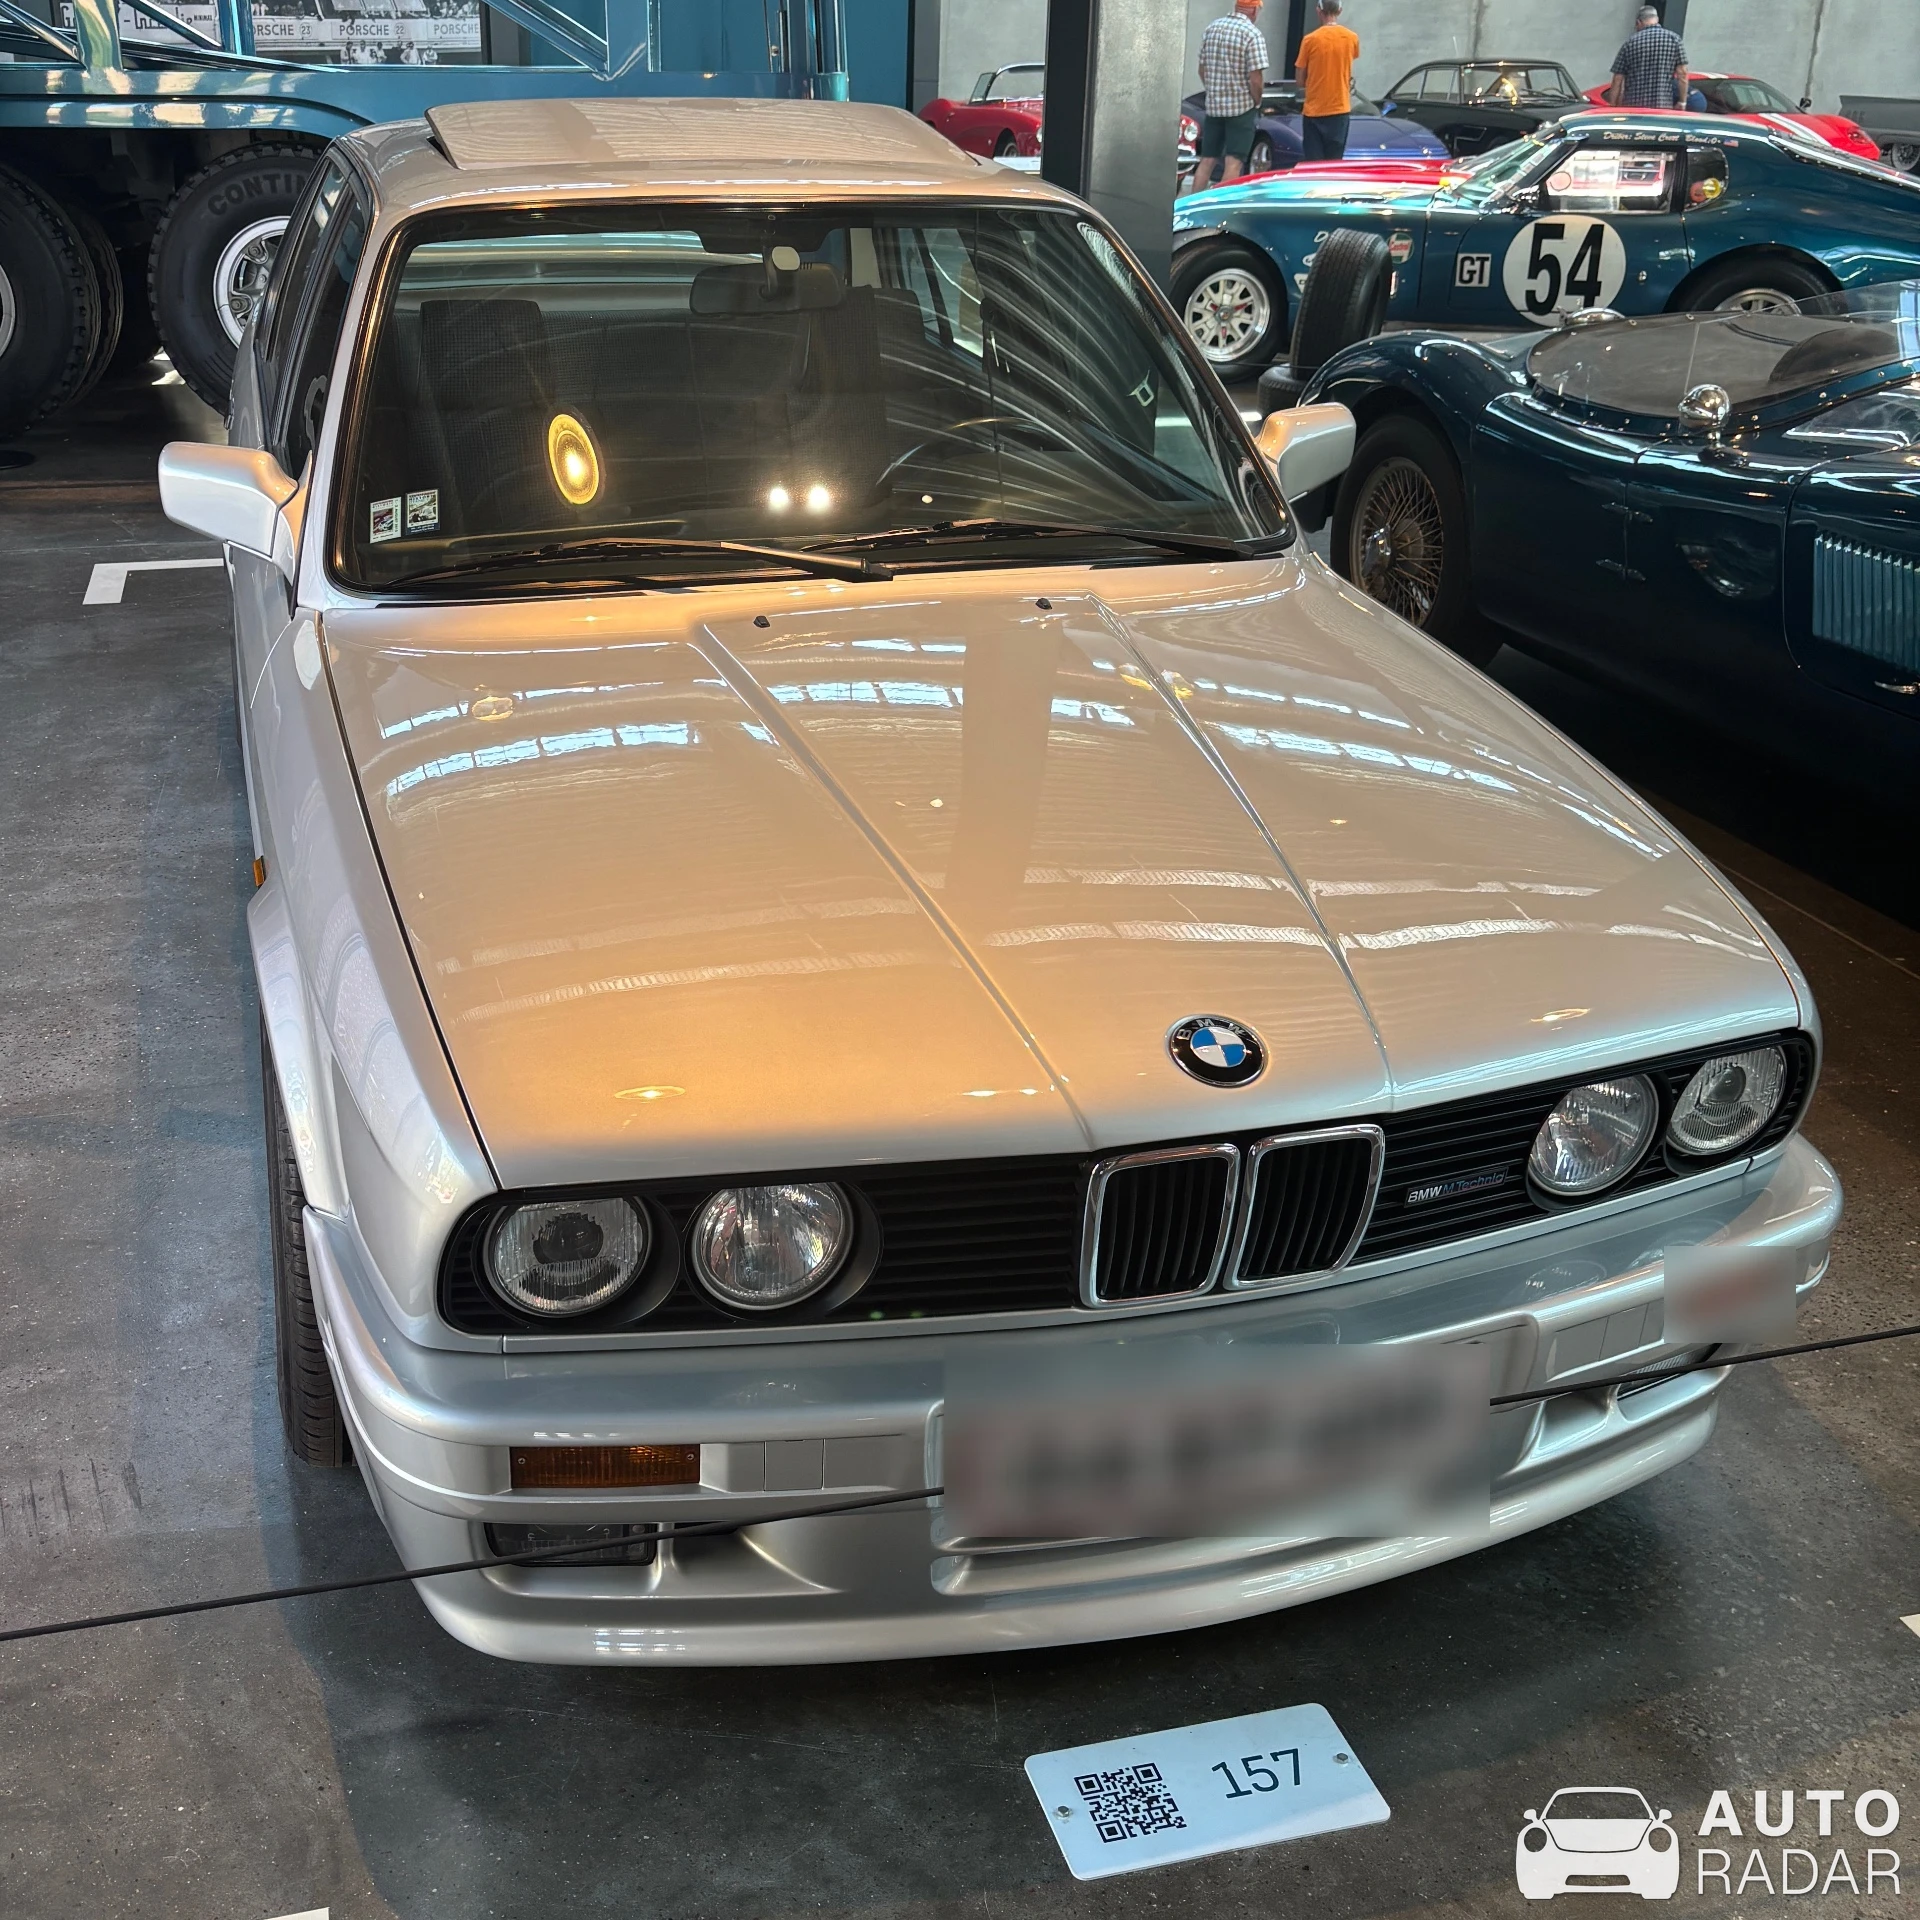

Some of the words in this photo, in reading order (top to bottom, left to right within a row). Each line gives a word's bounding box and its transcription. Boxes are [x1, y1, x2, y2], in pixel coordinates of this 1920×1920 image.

[301, 25, 311, 35] 23
[339, 24, 390, 36] PORSCHE
[395, 24, 405, 35] 22
[433, 23, 479, 35] PORSCHE
[1458, 255, 1490, 285] GT
[1525, 223, 1605, 316] 54
[1176, 1018, 1246, 1041] BMW
[1407, 1185, 1442, 1203] BMW
[1211, 1748, 1301, 1799] 157
